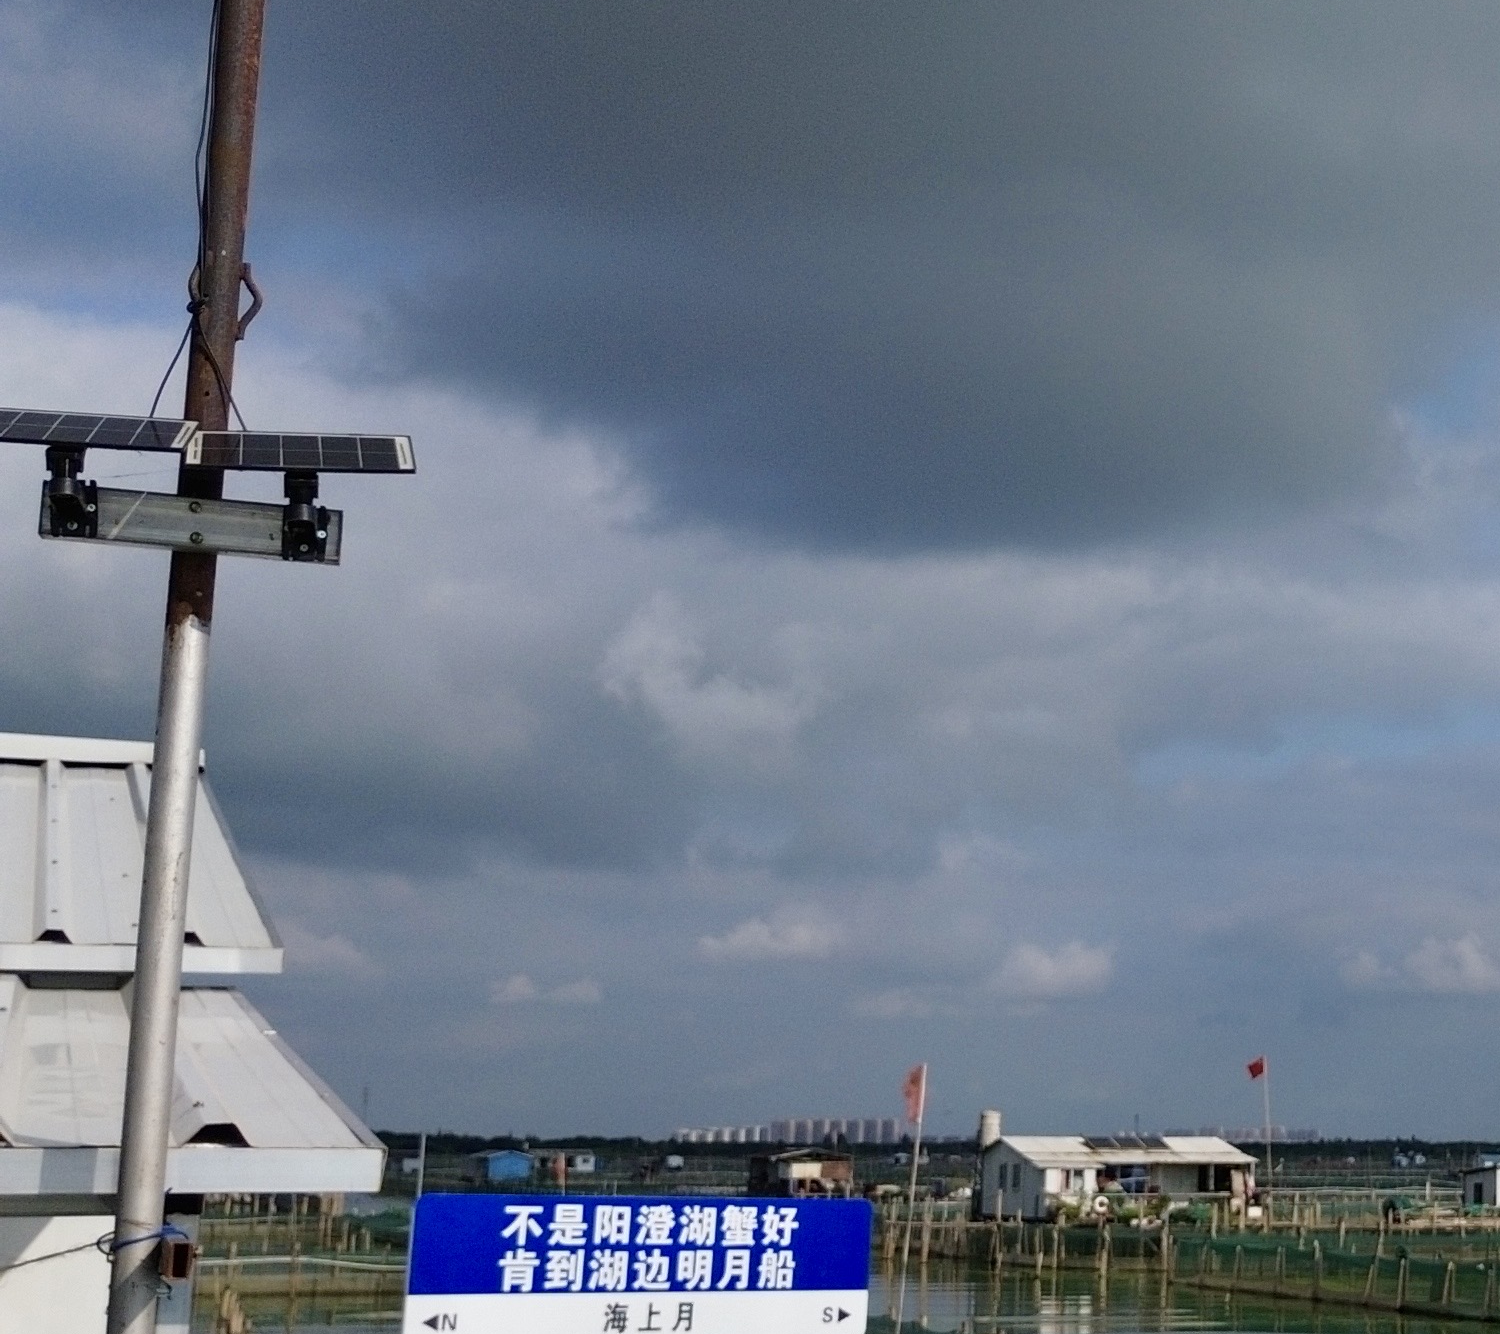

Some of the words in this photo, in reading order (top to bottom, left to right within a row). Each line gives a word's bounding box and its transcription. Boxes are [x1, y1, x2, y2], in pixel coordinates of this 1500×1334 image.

[501, 1204, 799, 1246] 不是阳澄湖蟹好
[499, 1248, 796, 1292] 肯到湖边明月船
[441, 1313, 458, 1331] N
[603, 1302, 695, 1334] 海上月
[822, 1307, 833, 1323] S
